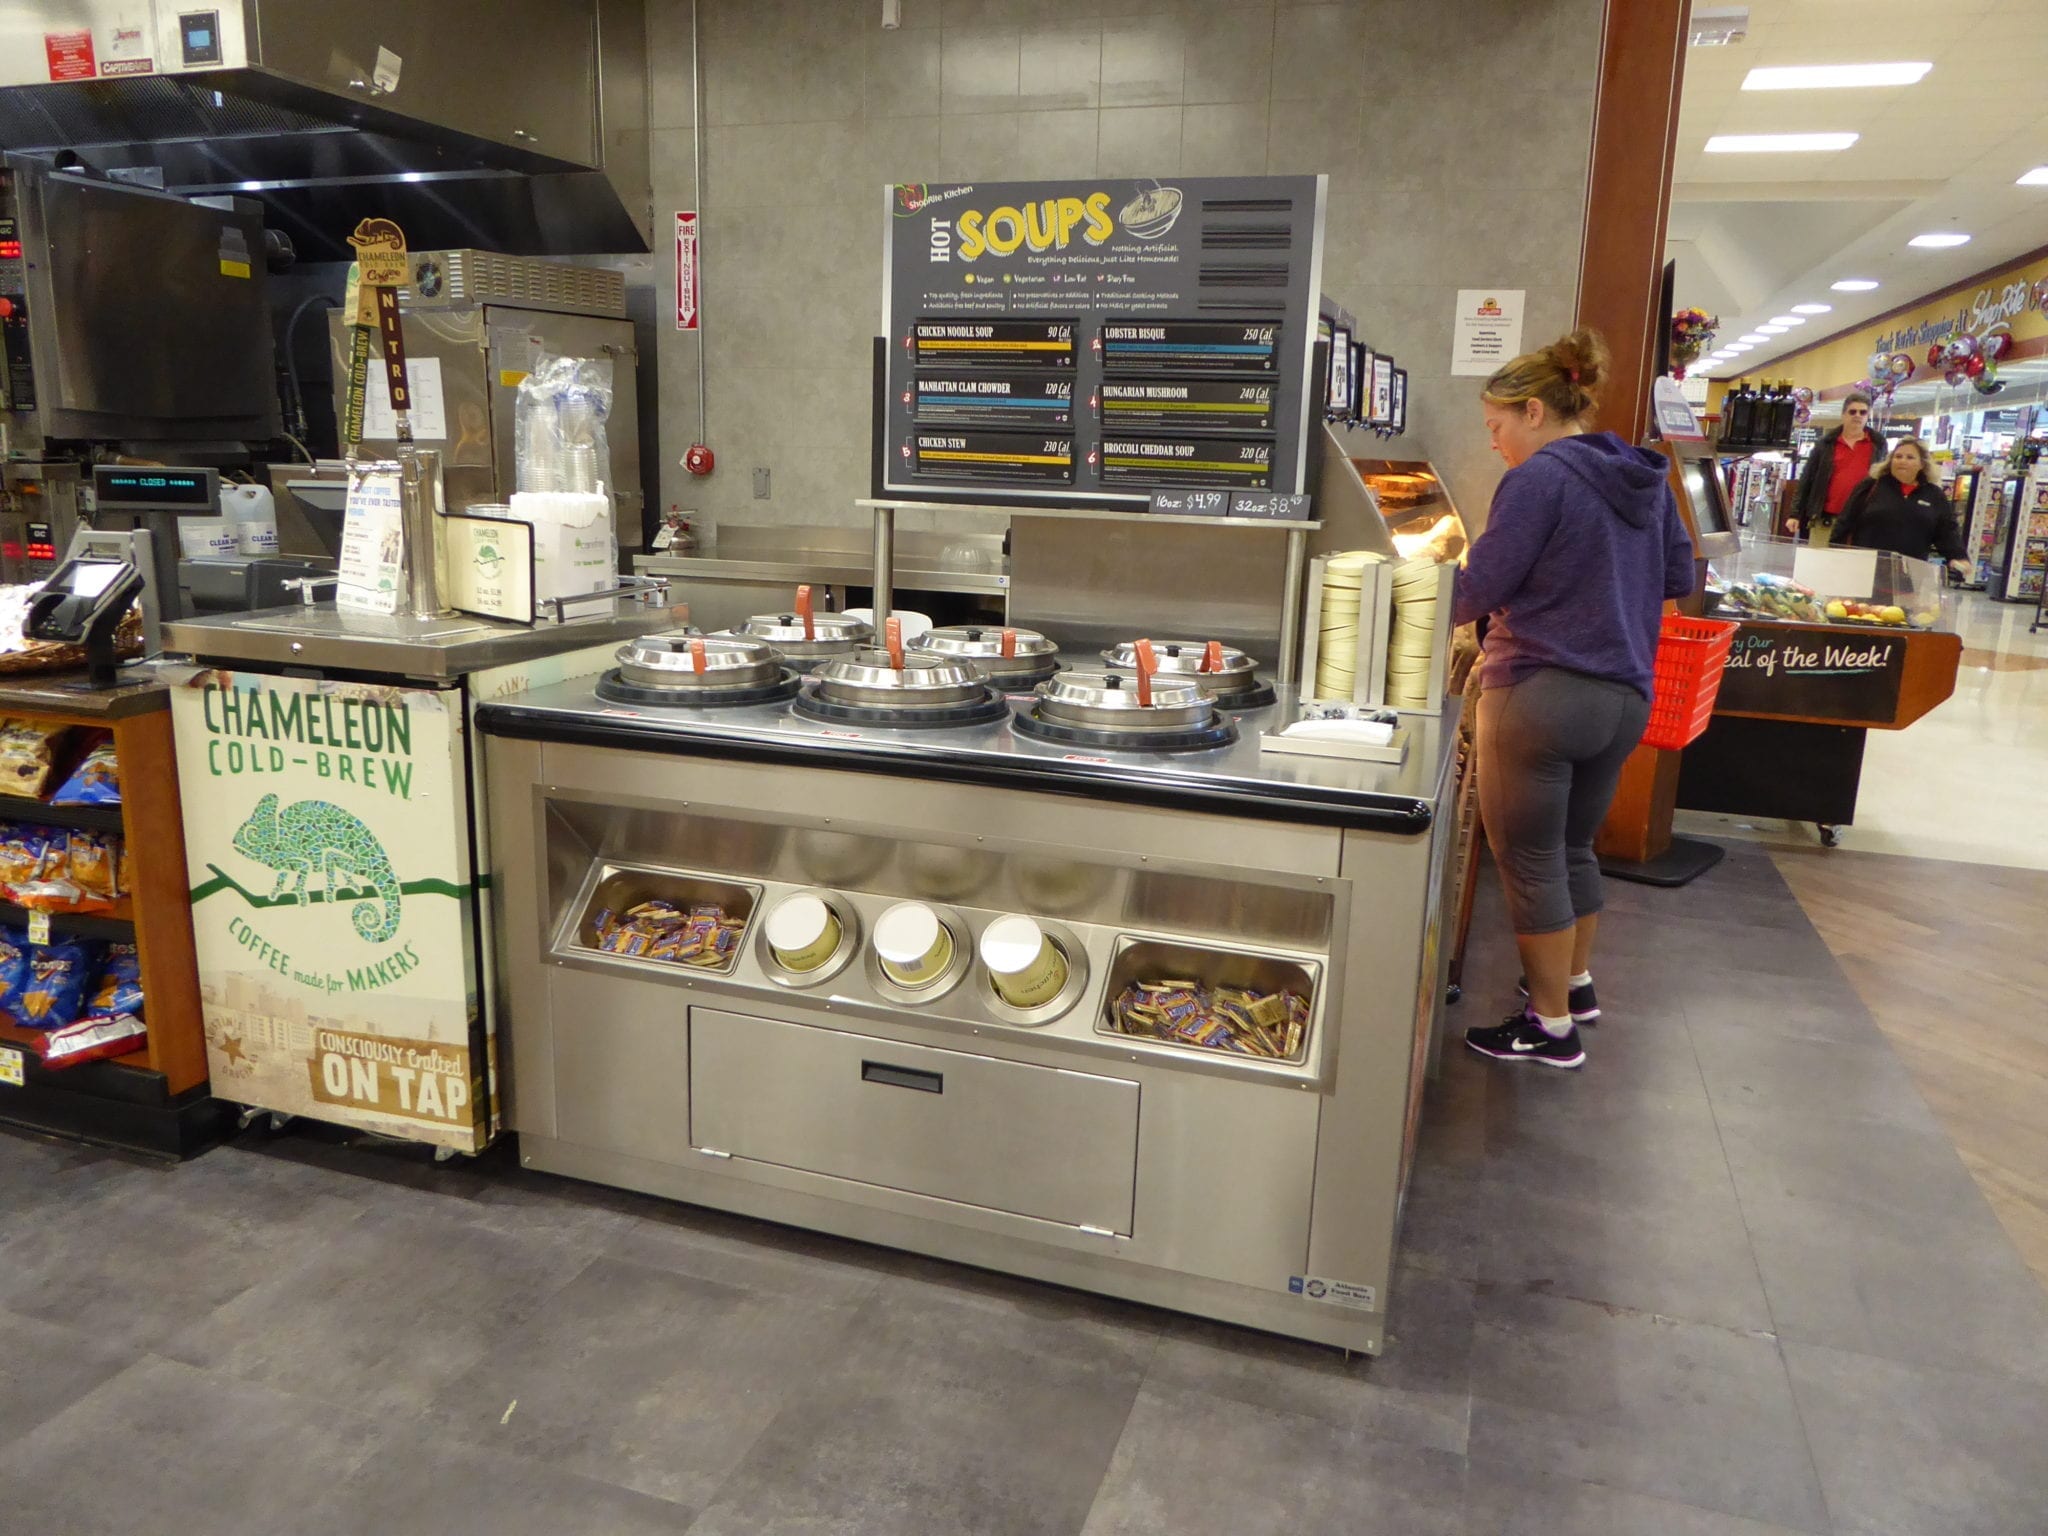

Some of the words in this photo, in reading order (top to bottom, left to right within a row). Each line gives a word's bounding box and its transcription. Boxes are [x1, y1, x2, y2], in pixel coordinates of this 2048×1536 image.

[909, 194, 943, 210] ShopRite
[943, 185, 974, 199] Kitchen
[678, 226, 695, 236] FIRE
[956, 191, 1115, 263] SOUPS
[930, 217, 950, 263] HOT
[1112, 244, 1141, 254] Nothing
[358, 252, 406, 261] CHAMELEON
[1027, 256, 1067, 267] Everything
[1100, 255, 1117, 265] Just
[1119, 255, 1136, 263] Like
[1137, 255, 1179, 263] Homemade!
[683, 239, 691, 312] EXTINGUISHER
[976, 274, 995, 284] Vegan
[1014, 274, 1046, 284] Vegetarian
[1064, 274, 1076, 283] Low
[1076, 274, 1087, 283] Fat
[1918, 315, 1954, 345] Shopping
[1955, 309, 1968, 331] At
[1967, 278, 2027, 336] ShopRite
[917, 326, 947, 337] CHICKEN
[947, 326, 974, 338] NOODLE
[975, 327, 994, 338] SOUP
[1047, 326, 1058, 338] 90
[1059, 325, 1071, 338] Cal.
[1105, 327, 1137, 339] LOBSTER
[1138, 328, 1165, 340] BISQUE
[1243, 328, 1259, 340] 250
[1259, 328, 1273, 340] Cal.
[381, 293, 406, 401] NITRO
[355, 330, 369, 385] COLD-BREW
[918, 381, 958, 392] MANHATTAN
[958, 382, 977, 393] CLAM
[977, 382, 1011, 394] CHOWDER
[1045, 383, 1057, 394] 120
[1058, 383, 1071, 395] Cal.
[1103, 386, 1145, 398] HUNGARIAN
[1146, 386, 1188, 398] MUSHROOM
[1239, 388, 1255, 399] 240
[1255, 387, 1270, 400] Cal.
[350, 387, 364, 442] CHAMELEON
[918, 436, 947, 448] CHICKEN
[947, 438, 967, 448] STEW
[1043, 441, 1057, 452] 230
[1058, 440, 1071, 453] Cal.
[1104, 442, 1139, 454] BROCCOLI
[1140, 444, 1174, 456] CHEDDAR
[1175, 446, 1195, 457] SOUP
[1240, 447, 1254, 459] 320
[1255, 447, 1269, 459] Cal.
[1088, 452, 1096, 463] 6
[139, 478, 167, 487] CLOSED
[1156, 495, 1182, 508] 16oz:
[1186, 492, 1221, 510] $4.99
[1235, 499, 1268, 513] 32oz:
[251, 535, 273, 543] CLEAN
[1730, 640, 1744, 653] ry
[1747, 635, 1774, 649] Our
[1723, 649, 1752, 668] eal
[1756, 649, 1778, 677] of
[1782, 645, 1819, 667] the
[1824, 644, 1892, 668] Week!
[203, 683, 412, 756] CHAMELEON
[208, 739, 413, 800] COLD-BREW
[228, 916, 290, 976] COFFEE
[293, 970, 325, 991] made
[325, 974, 345, 996] for
[345, 942, 420, 992] MAKERS
[1020, 970, 1053, 994] Kitchen
[319, 1031, 403, 1065] CONSCIOUSLY
[407, 1048, 464, 1078] Crafted
[322, 1053, 380, 1103] ON
[392, 1068, 467, 1120] TAP
[1331, 1288, 1351, 1297] Food
